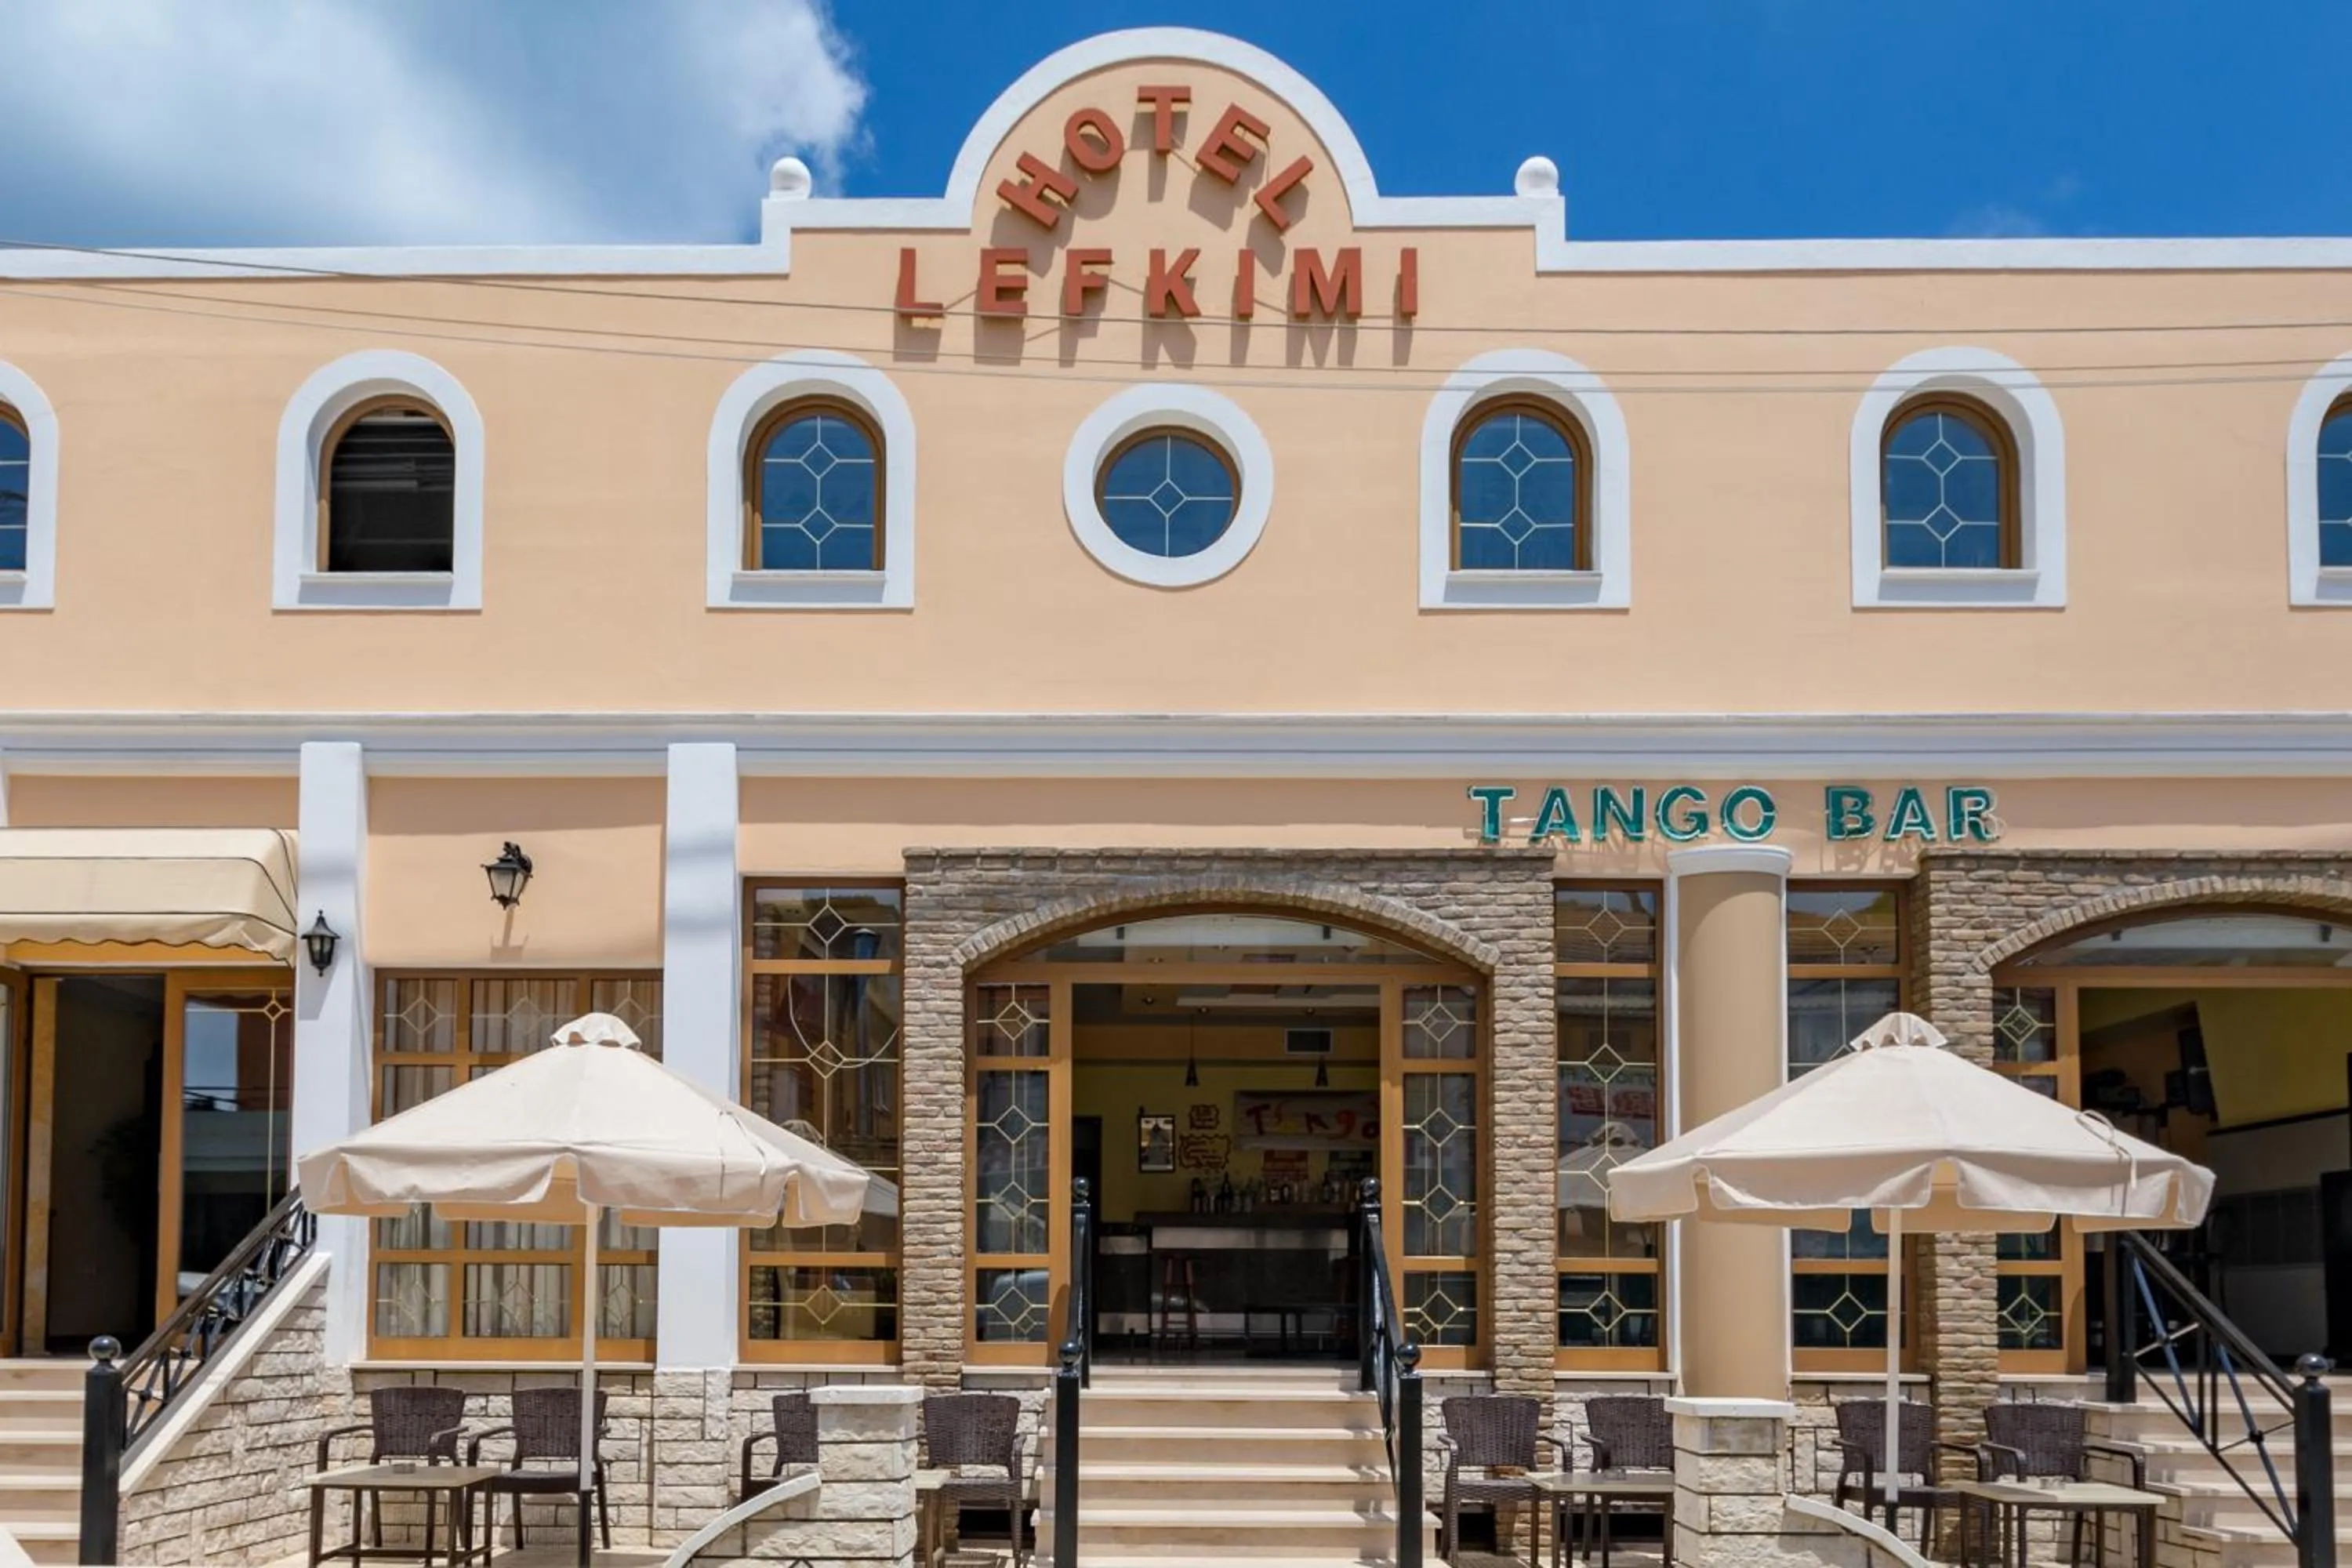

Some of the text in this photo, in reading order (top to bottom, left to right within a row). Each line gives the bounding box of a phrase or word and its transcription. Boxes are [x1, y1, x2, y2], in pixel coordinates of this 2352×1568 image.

[996, 85, 1314, 230] HOTEL
[894, 246, 1418, 318] LEFKIMI
[1467, 785, 1998, 844] TANGO BAR
